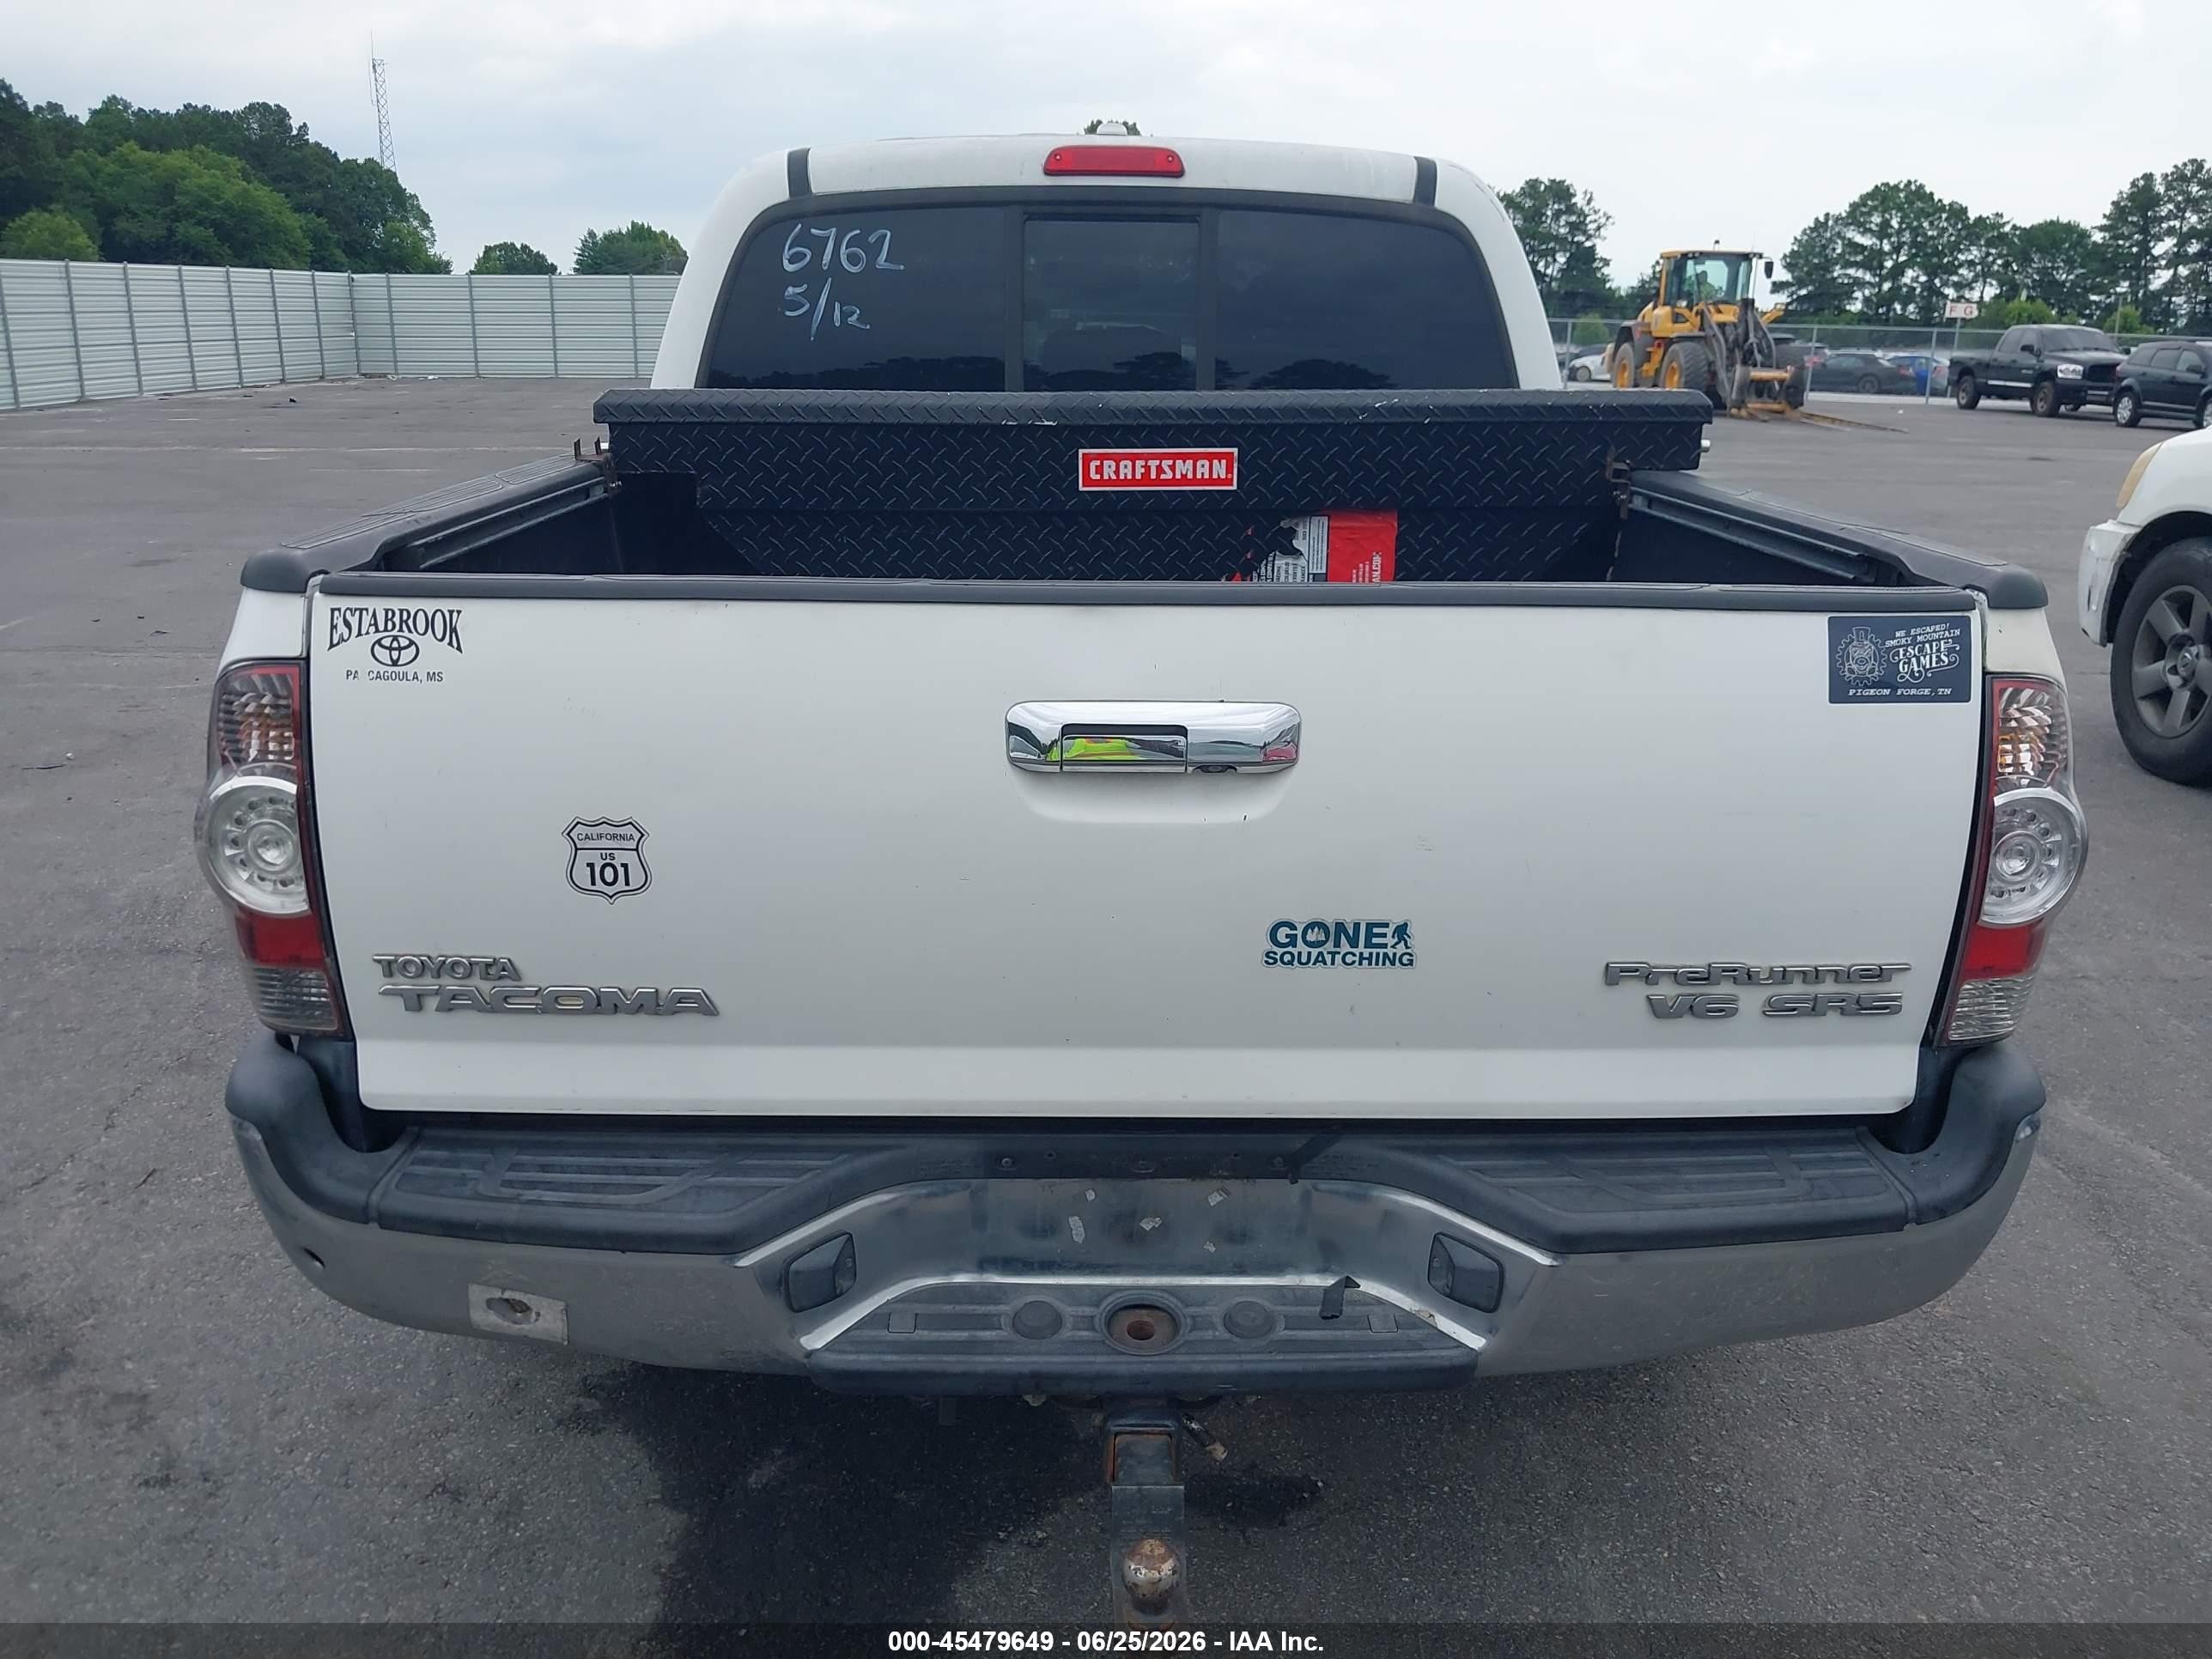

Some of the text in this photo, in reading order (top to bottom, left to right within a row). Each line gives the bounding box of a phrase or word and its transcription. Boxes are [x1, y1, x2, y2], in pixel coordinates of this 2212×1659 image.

[782, 223, 905, 273] 6762
[784, 277, 871, 341] 5/12
[1089, 459, 1228, 481] CRAFTSMAN
[327, 606, 463, 654] ESTABROOK
[1885, 629, 1960, 648] SMOKY MOUNTAIN
[1894, 623, 1950, 638] WE ESCAPED!
[1893, 640, 1956, 660] ESCAPE
[1898, 652, 1955, 677] GAMES
[346, 670, 443, 684] PACAGOULA, MS
[1848, 688, 1891, 696] PIGEON
[576, 832, 636, 842] CALIFORNIA
[599, 852, 617, 861] US
[586, 862, 631, 887] 101
[1269, 921, 1390, 949] GONE
[373, 954, 522, 981] TOYOTA
[1263, 951, 1414, 967] SQUATCHING
[1605, 962, 1912, 986] PreRunner
[379, 985, 720, 1016] TACOMA
[1647, 993, 1904, 1019] V6 SR5
